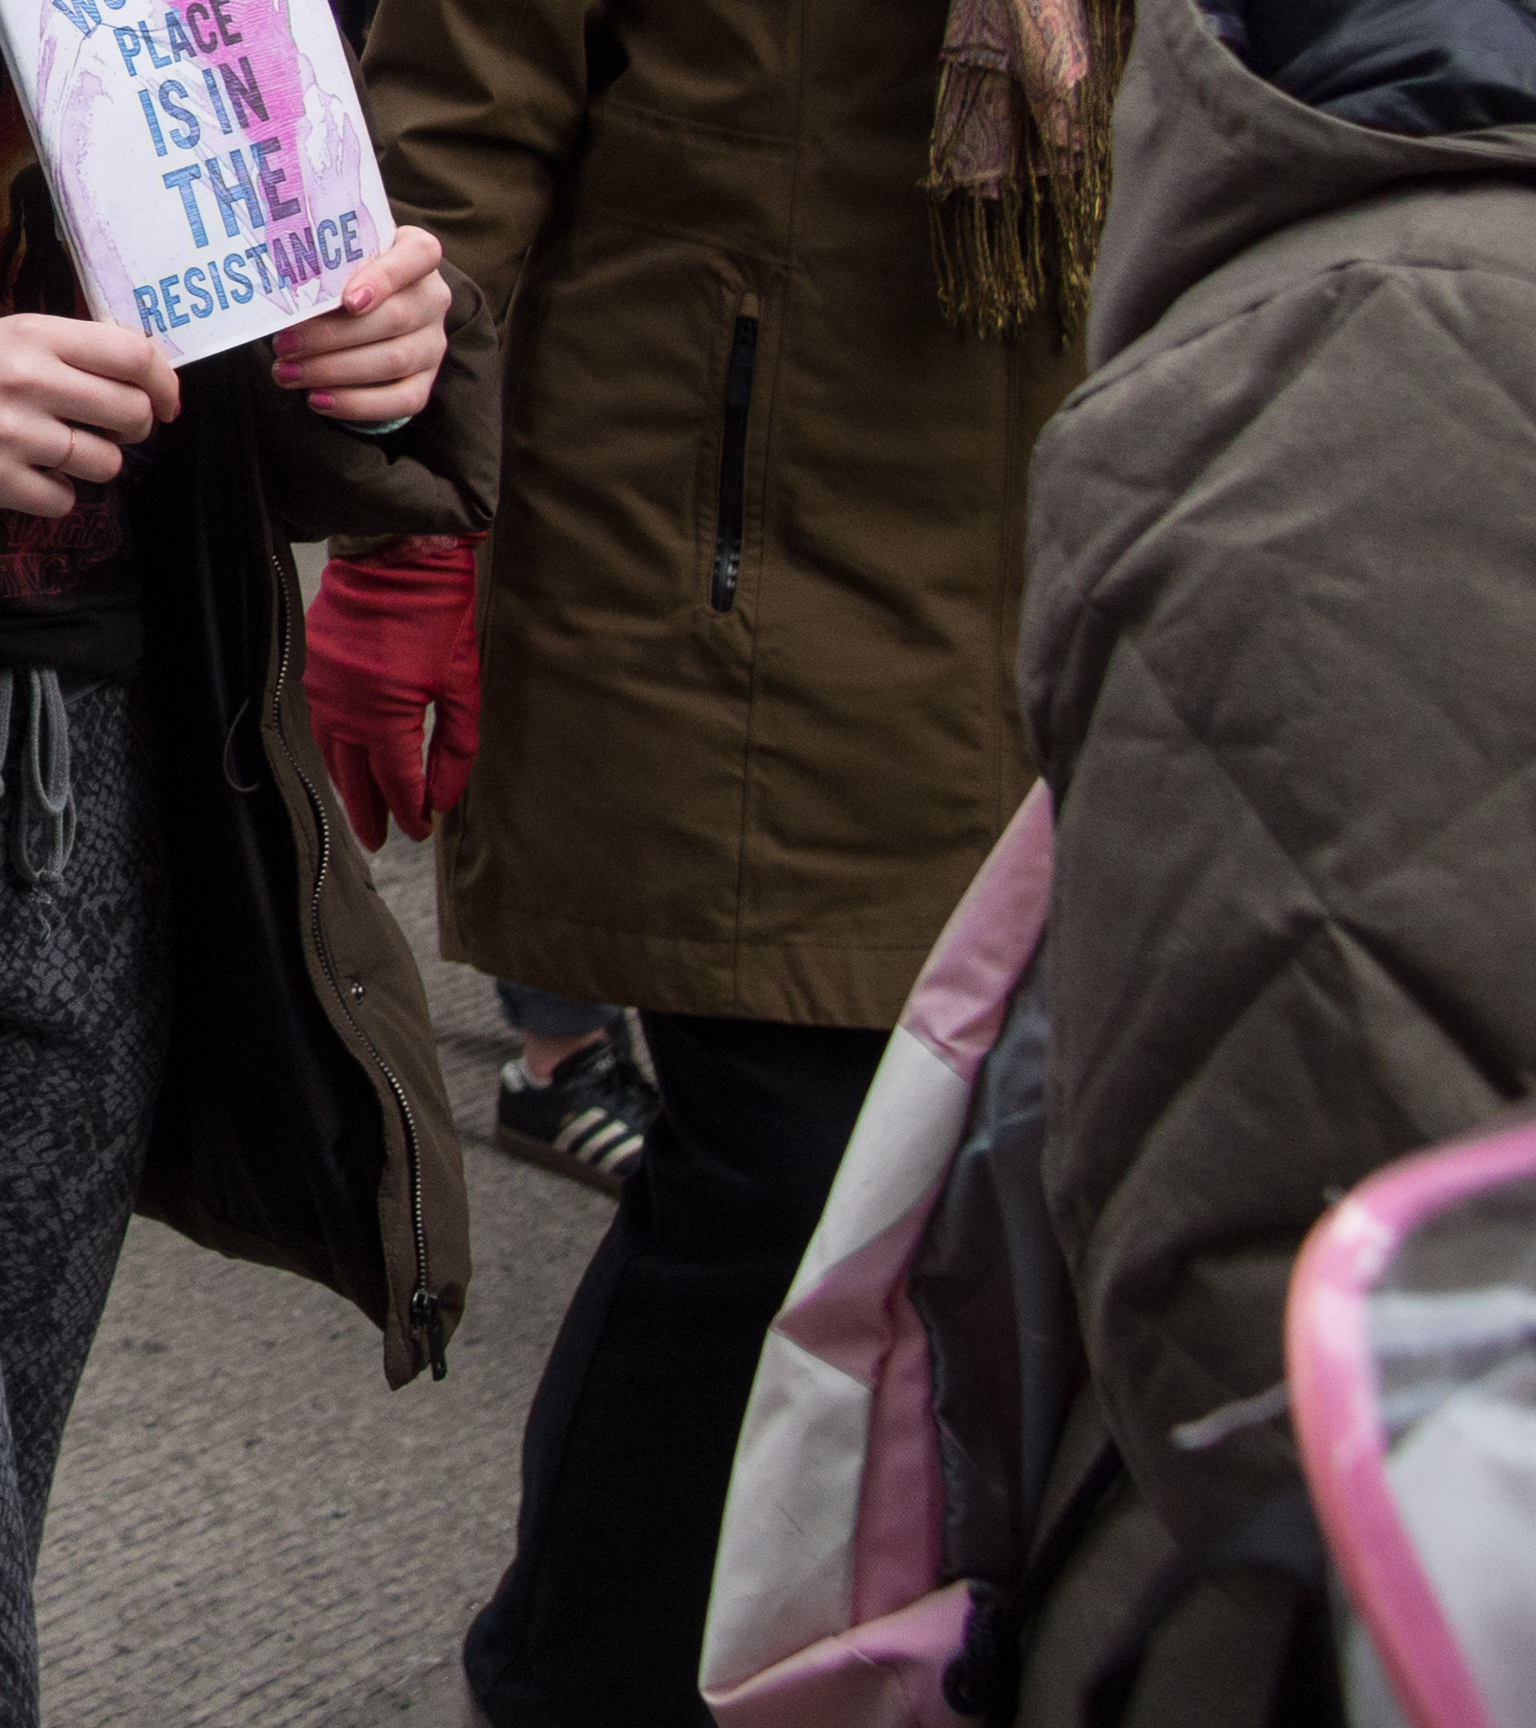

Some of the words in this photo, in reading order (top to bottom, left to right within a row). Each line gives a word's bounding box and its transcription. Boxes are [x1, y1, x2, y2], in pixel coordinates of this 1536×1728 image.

[137, 79, 202, 158] IS
[205, 55, 270, 138] IN
[162, 137, 304, 250] THE
[133, 210, 364, 338] RESISTANCE
